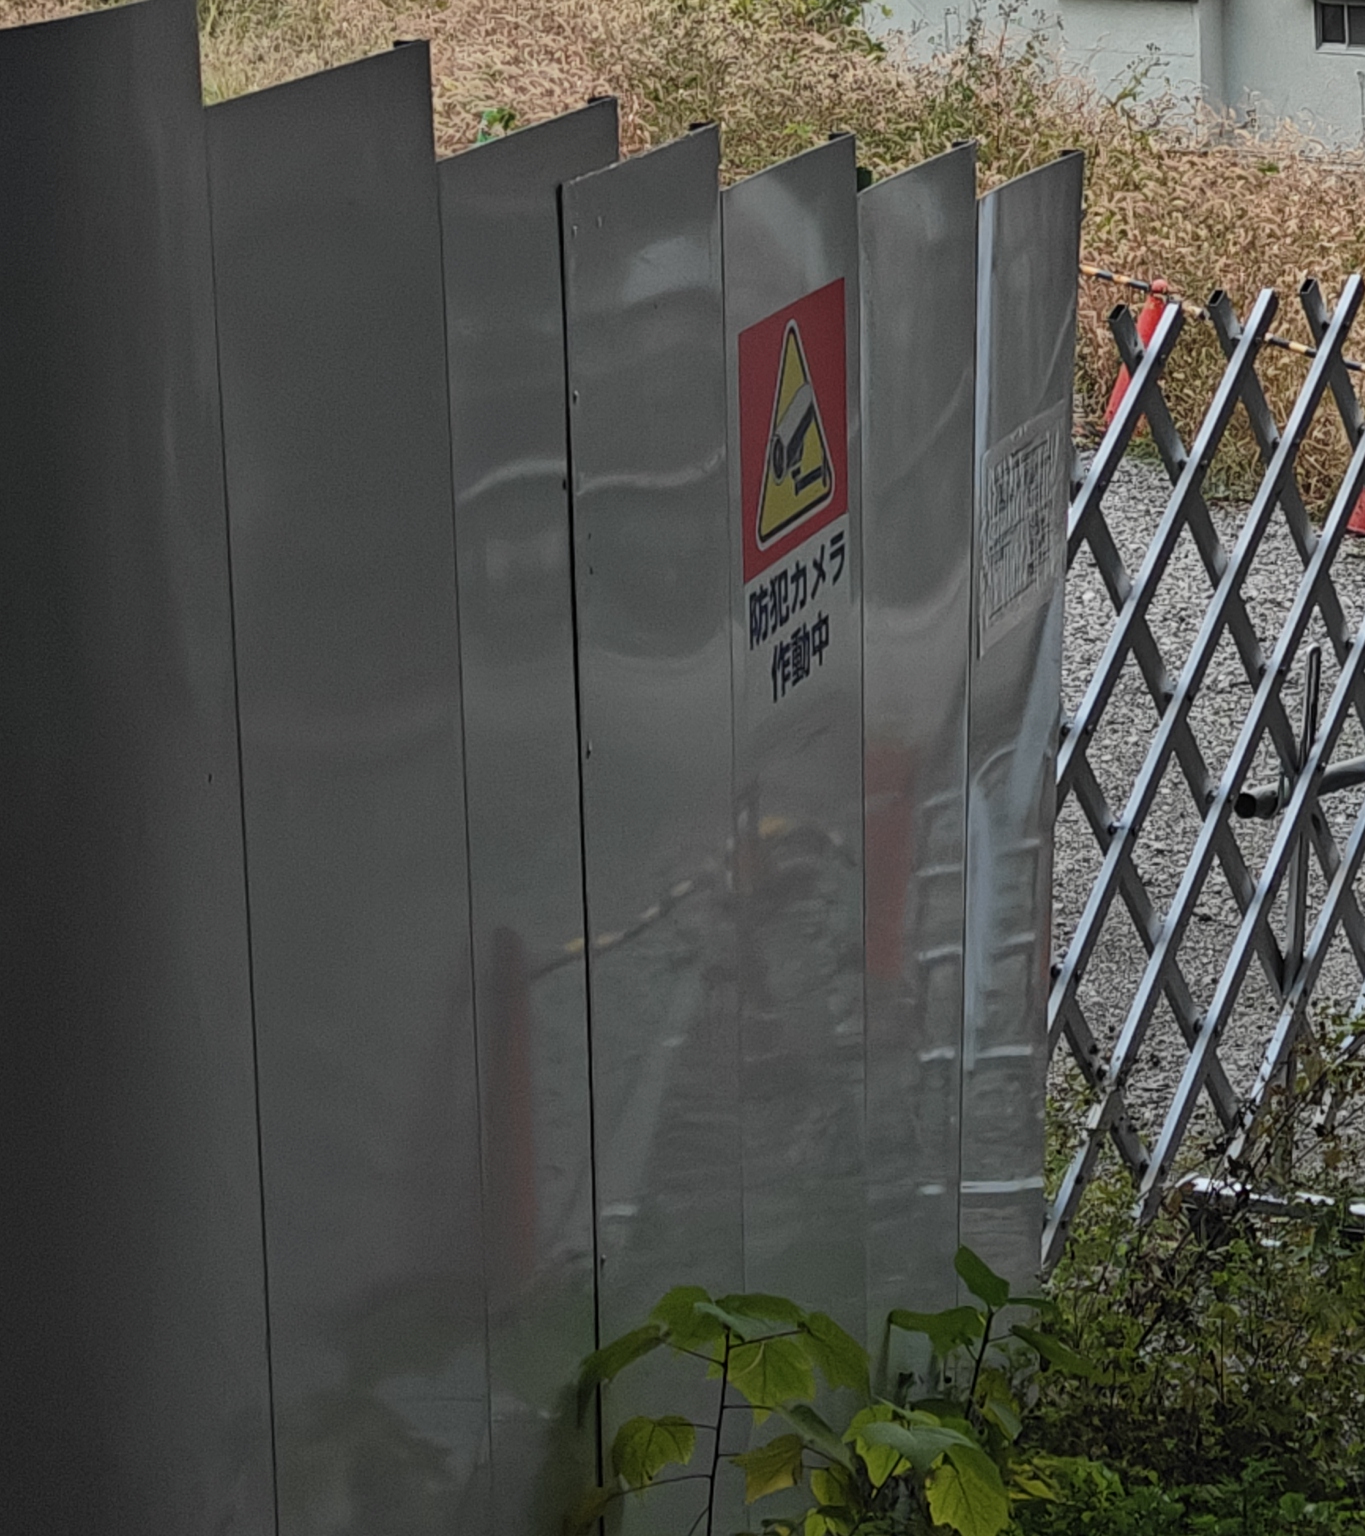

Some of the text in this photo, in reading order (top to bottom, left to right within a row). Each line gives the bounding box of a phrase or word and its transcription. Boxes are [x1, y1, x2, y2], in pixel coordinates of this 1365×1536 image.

[750, 530, 846, 650] 防犯カメラ
[771, 610, 829, 703] 作動中
